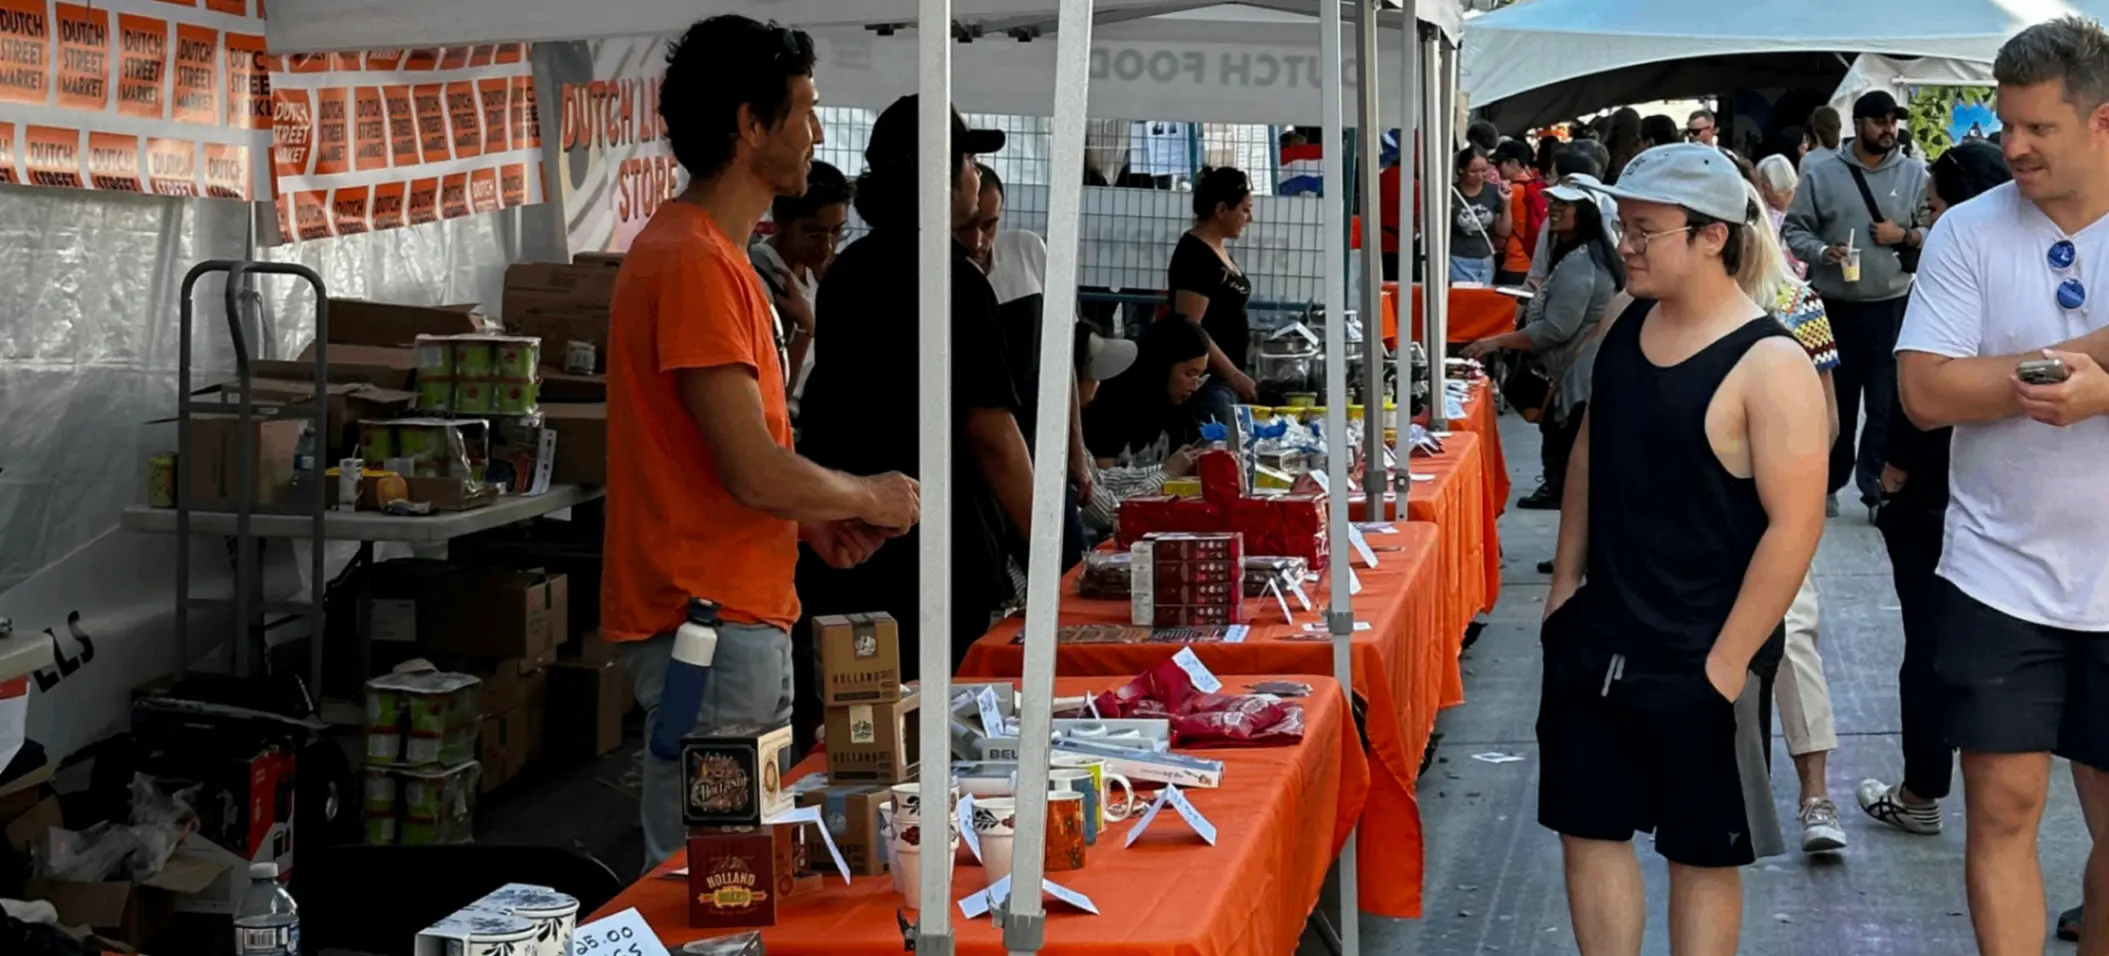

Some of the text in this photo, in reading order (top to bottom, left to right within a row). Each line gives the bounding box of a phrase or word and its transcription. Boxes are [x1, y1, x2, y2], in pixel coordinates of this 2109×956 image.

[0, 8, 44, 37] DUTCH
[62, 18, 105, 48] DUTCH
[0, 38, 44, 66] STREET
[124, 29, 163, 55] DUTCH
[178, 37, 213, 63] DUTCH
[63, 46, 105, 76] STREET
[124, 57, 162, 82] STREET
[230, 47, 266, 71] DUTC
[62, 75, 104, 97] MARKET
[177, 65, 212, 90] STREET
[231, 72, 269, 95] STREE
[274, 101, 311, 122] DUTCH
[562, 80, 634, 152] DUTCH
[272, 122, 313, 145] STREET
[30, 141, 73, 168] DUTCH
[93, 147, 135, 171] DUTCH
[618, 154, 677, 222] STORE
[989, 748, 1018, 760] BEL
[706, 871, 757, 889] HOLLAND
